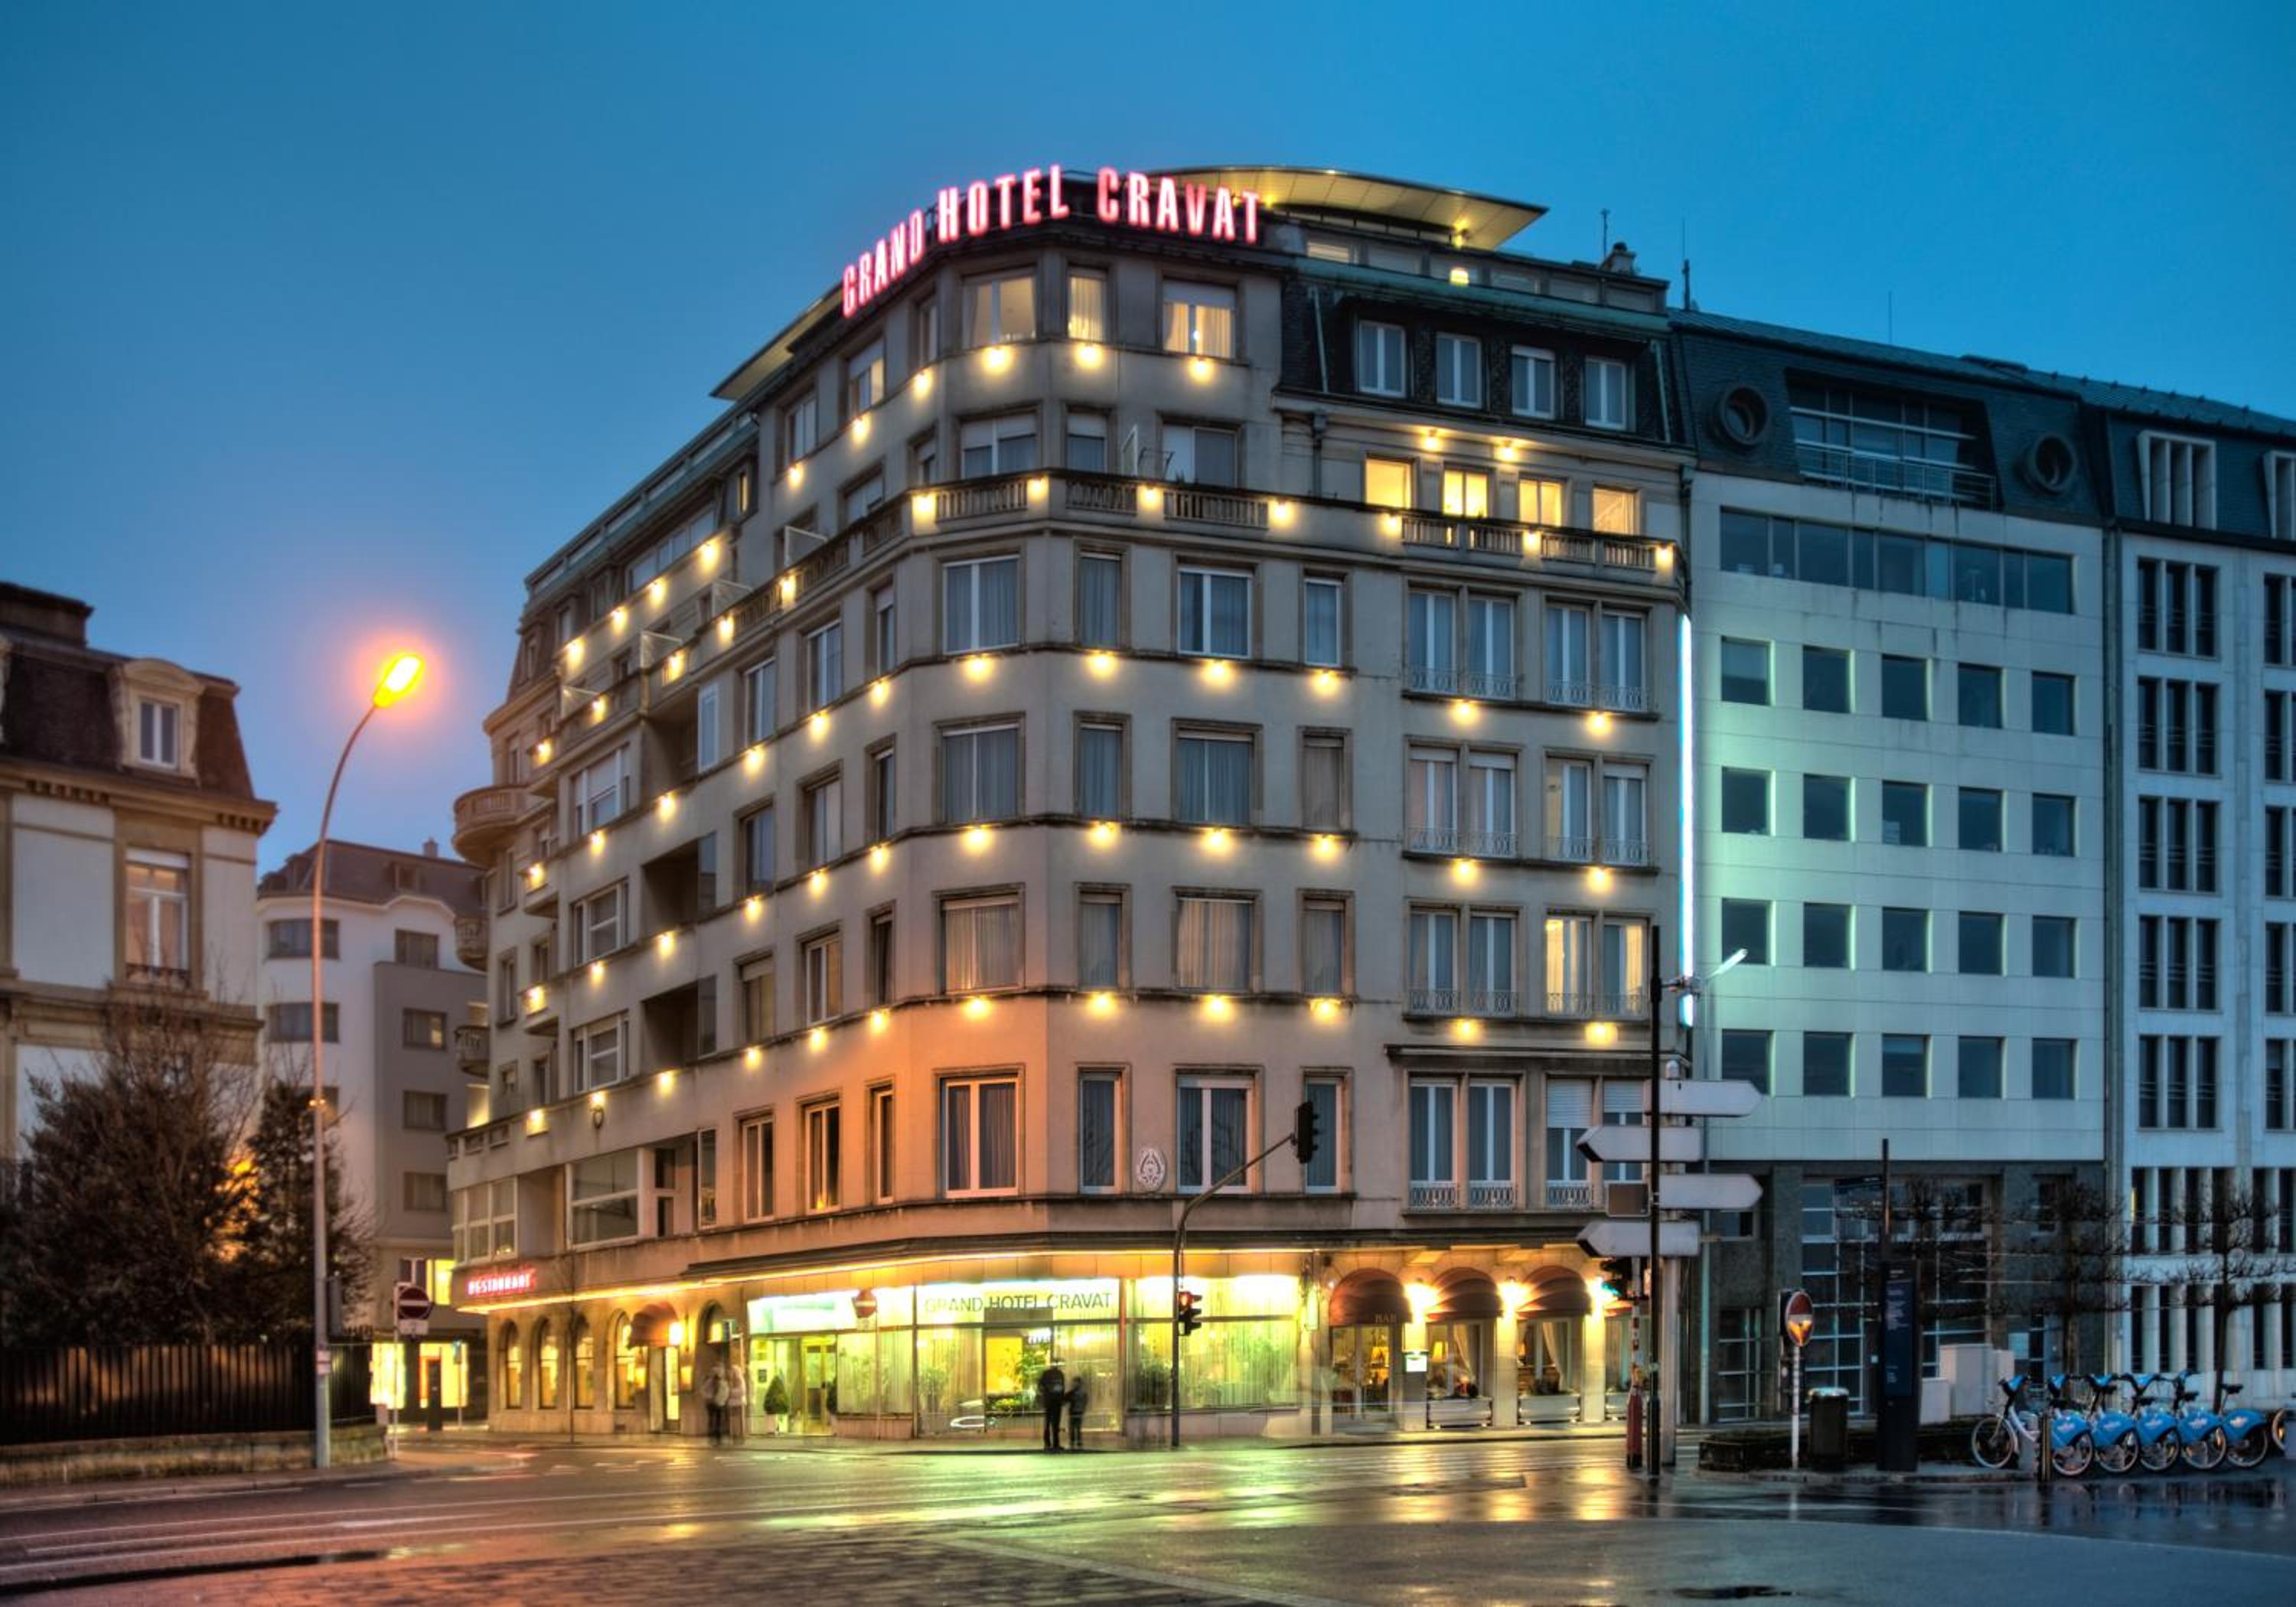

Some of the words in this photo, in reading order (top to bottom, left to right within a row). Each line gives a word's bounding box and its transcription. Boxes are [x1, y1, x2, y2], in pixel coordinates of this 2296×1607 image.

[842, 209, 925, 318] GRAND
[937, 165, 1070, 243] HOTEL
[1097, 166, 1261, 244] CRAVAT
[468, 1273, 532, 1296] RESTAURANT
[925, 1297, 983, 1312] GRAND
[989, 1295, 1041, 1311] HOTEL
[1047, 1292, 1112, 1309] CRAVAT
